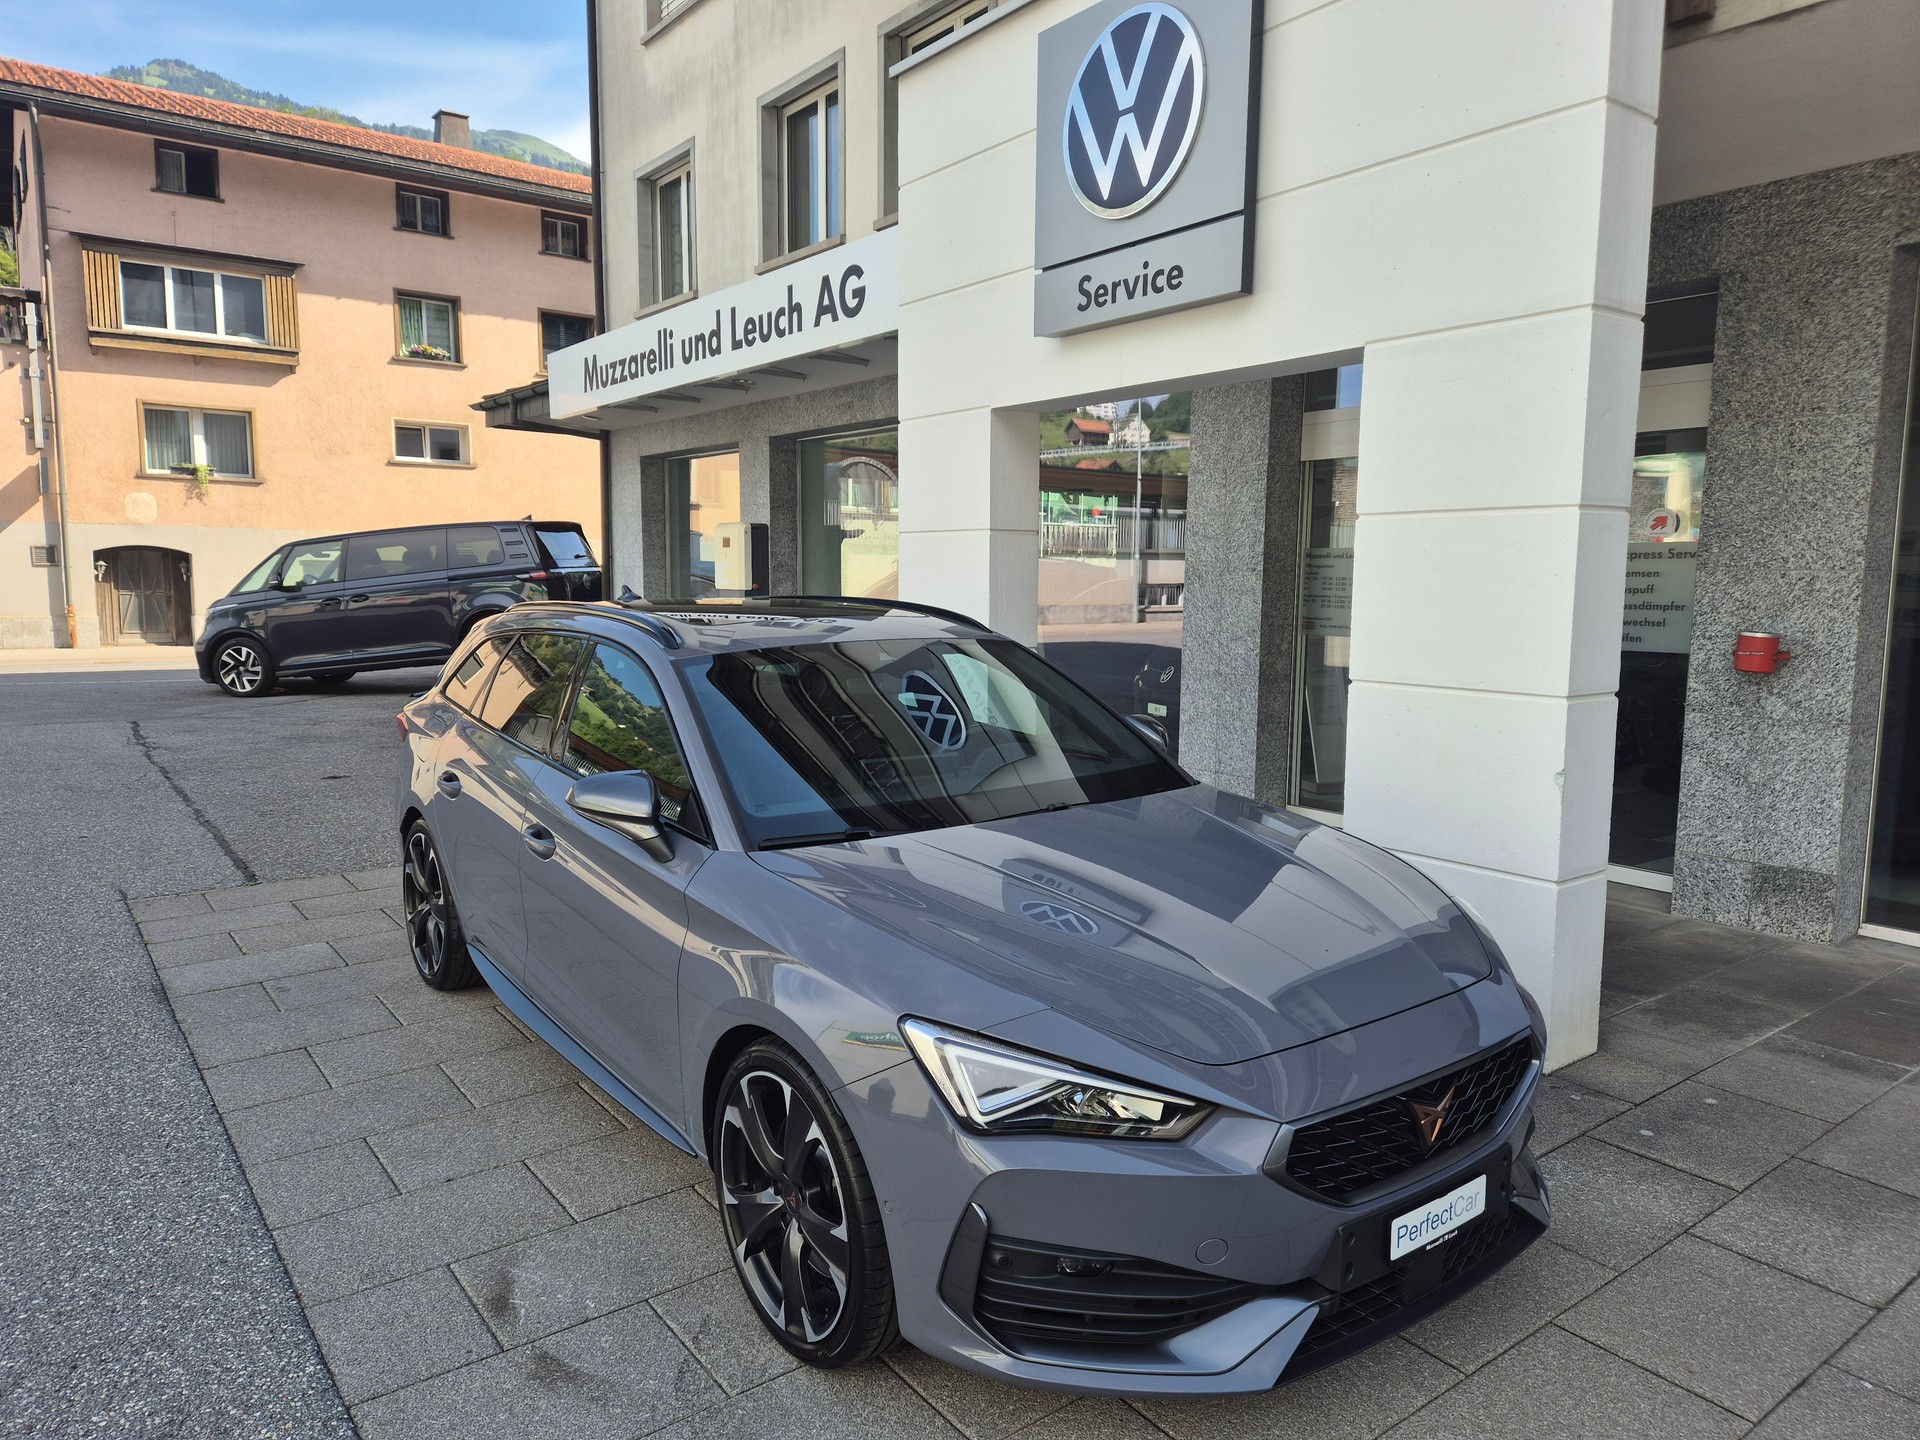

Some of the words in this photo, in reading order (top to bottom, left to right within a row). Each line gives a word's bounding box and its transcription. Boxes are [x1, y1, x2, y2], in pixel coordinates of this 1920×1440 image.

[1076, 260, 1184, 312] Service
[583, 327, 675, 394] Muzzarelli
[681, 309, 721, 365] und
[730, 284, 803, 351] Leuch
[813, 263, 867, 328] AG
[1396, 1191, 1480, 1249] PerfectCar
